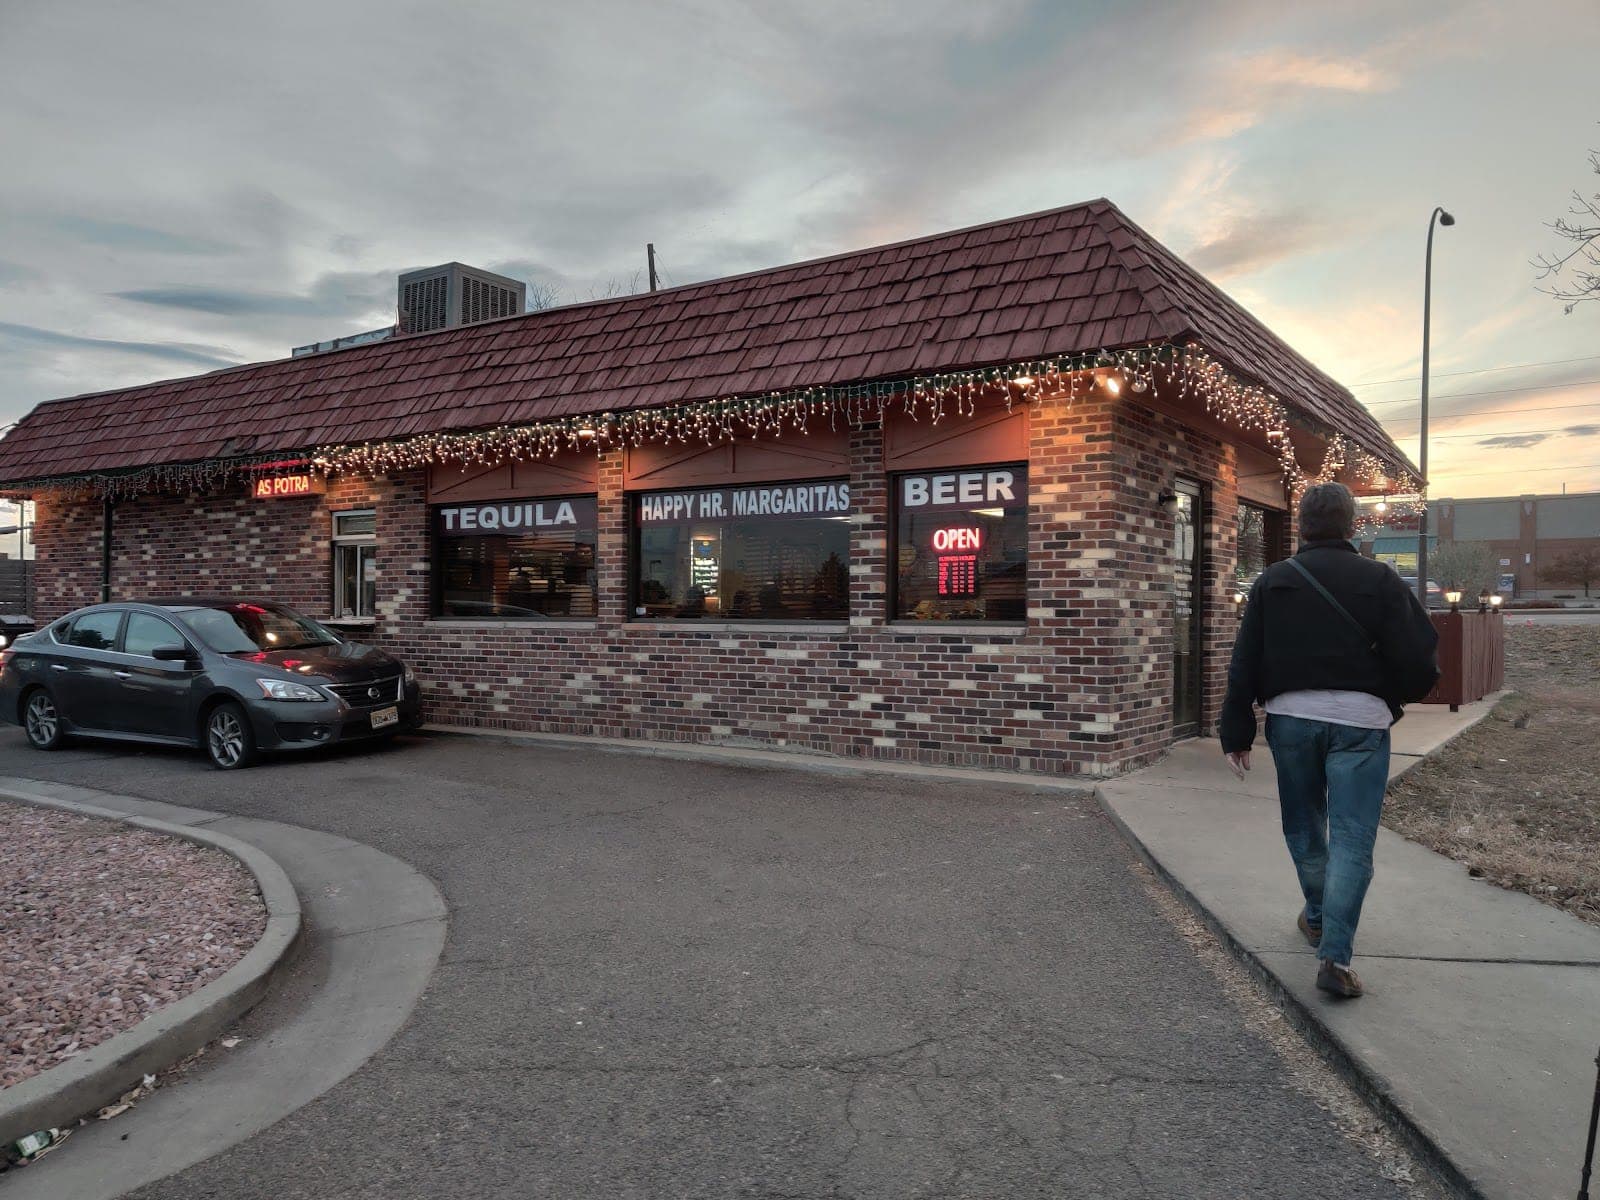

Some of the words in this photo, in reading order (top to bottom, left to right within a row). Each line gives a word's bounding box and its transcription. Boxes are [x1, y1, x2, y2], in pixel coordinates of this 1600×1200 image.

[257, 479, 271, 496] AS
[274, 475, 309, 494] POTRA
[904, 471, 1015, 507] BEER
[441, 502, 577, 530] TEQUILA
[642, 494, 694, 521] HAPPY
[700, 492, 727, 518] HR.
[732, 484, 850, 516] MARGARITAS
[933, 528, 980, 550] OPEN
